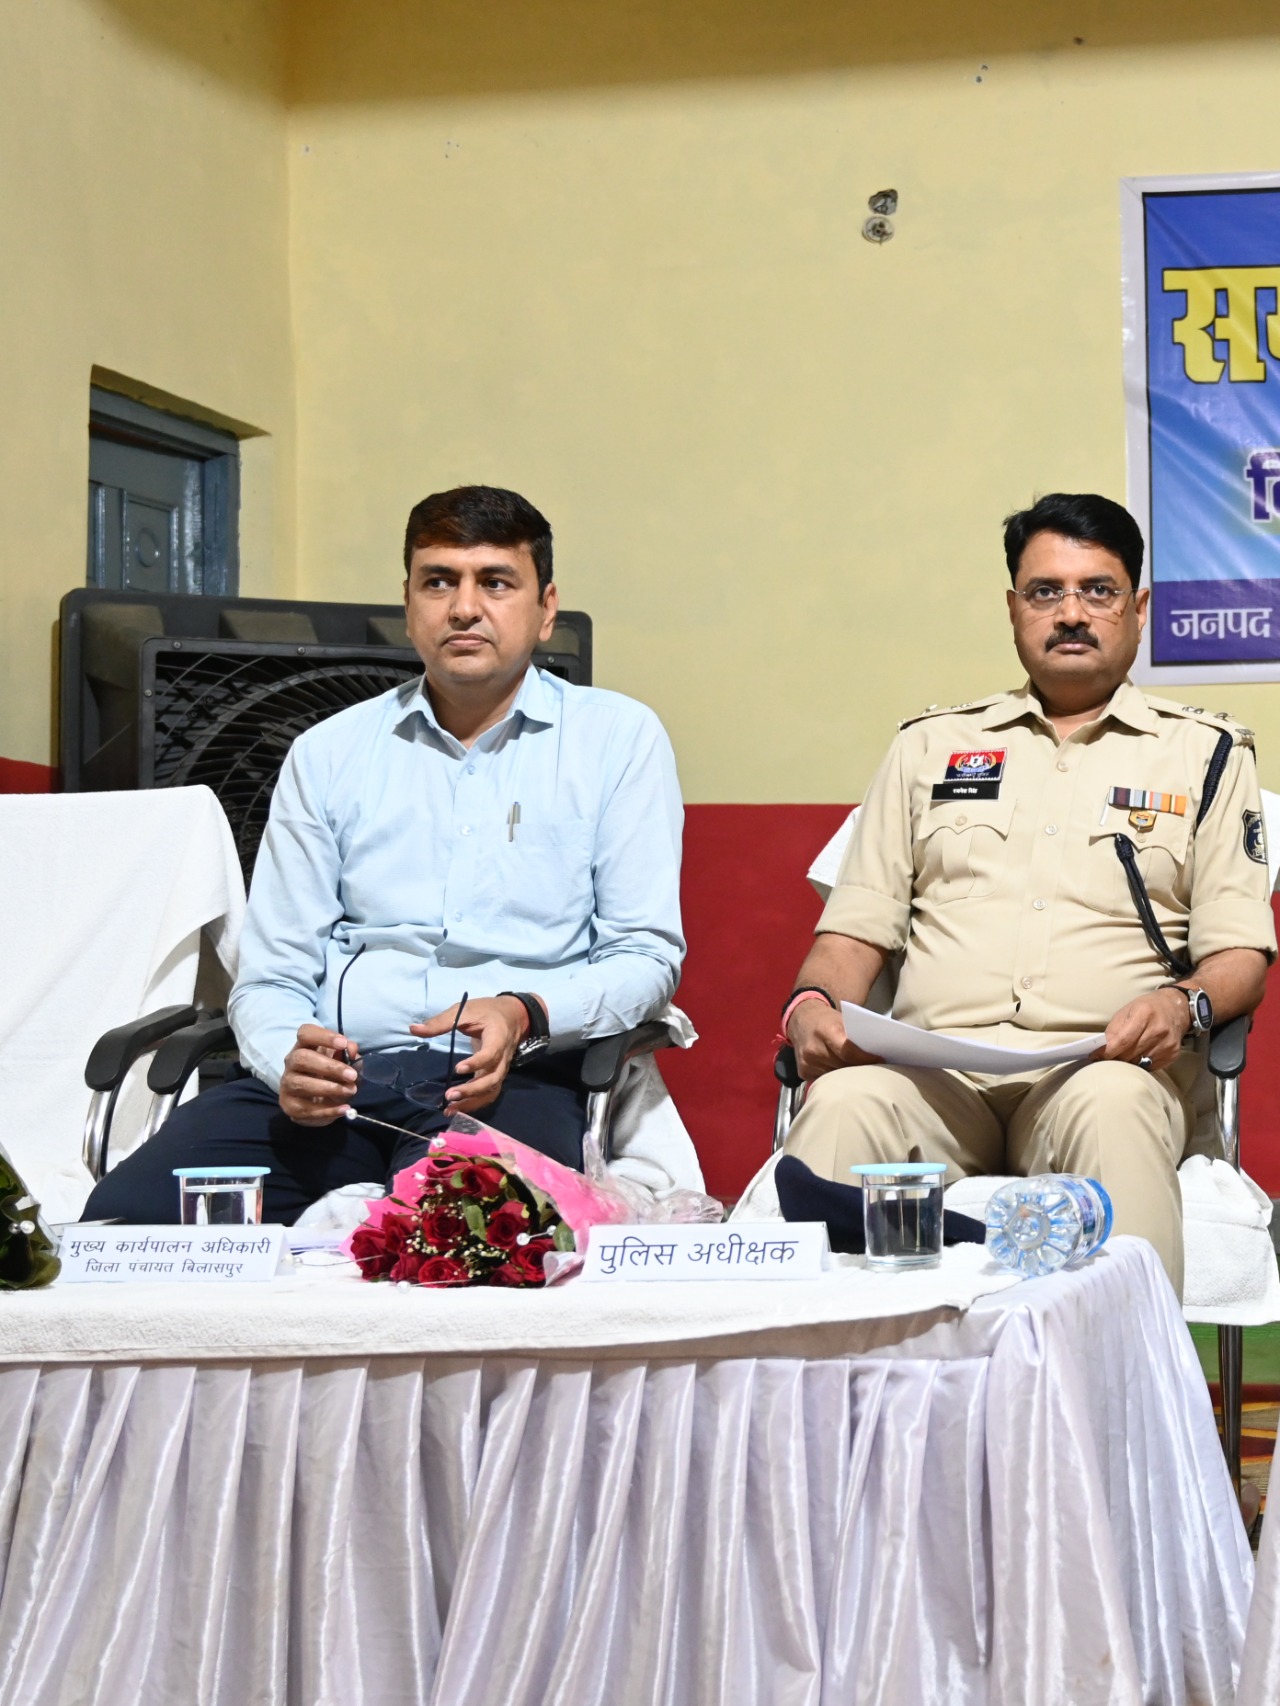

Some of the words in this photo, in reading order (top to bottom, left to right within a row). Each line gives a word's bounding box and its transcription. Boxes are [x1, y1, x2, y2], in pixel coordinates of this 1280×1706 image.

[1171, 607, 1273, 640] जनपद
[70, 1239, 106, 1258] मुख्य
[115, 1236, 194, 1254] कार्यपालन
[201, 1236, 272, 1255] अधिकारी
[599, 1236, 678, 1275] पुलिस
[687, 1233, 799, 1266] अधीक्षक
[85, 1258, 121, 1273] जिला
[128, 1259, 175, 1273] पंचायत
[181, 1258, 244, 1278] बिलासपुर
